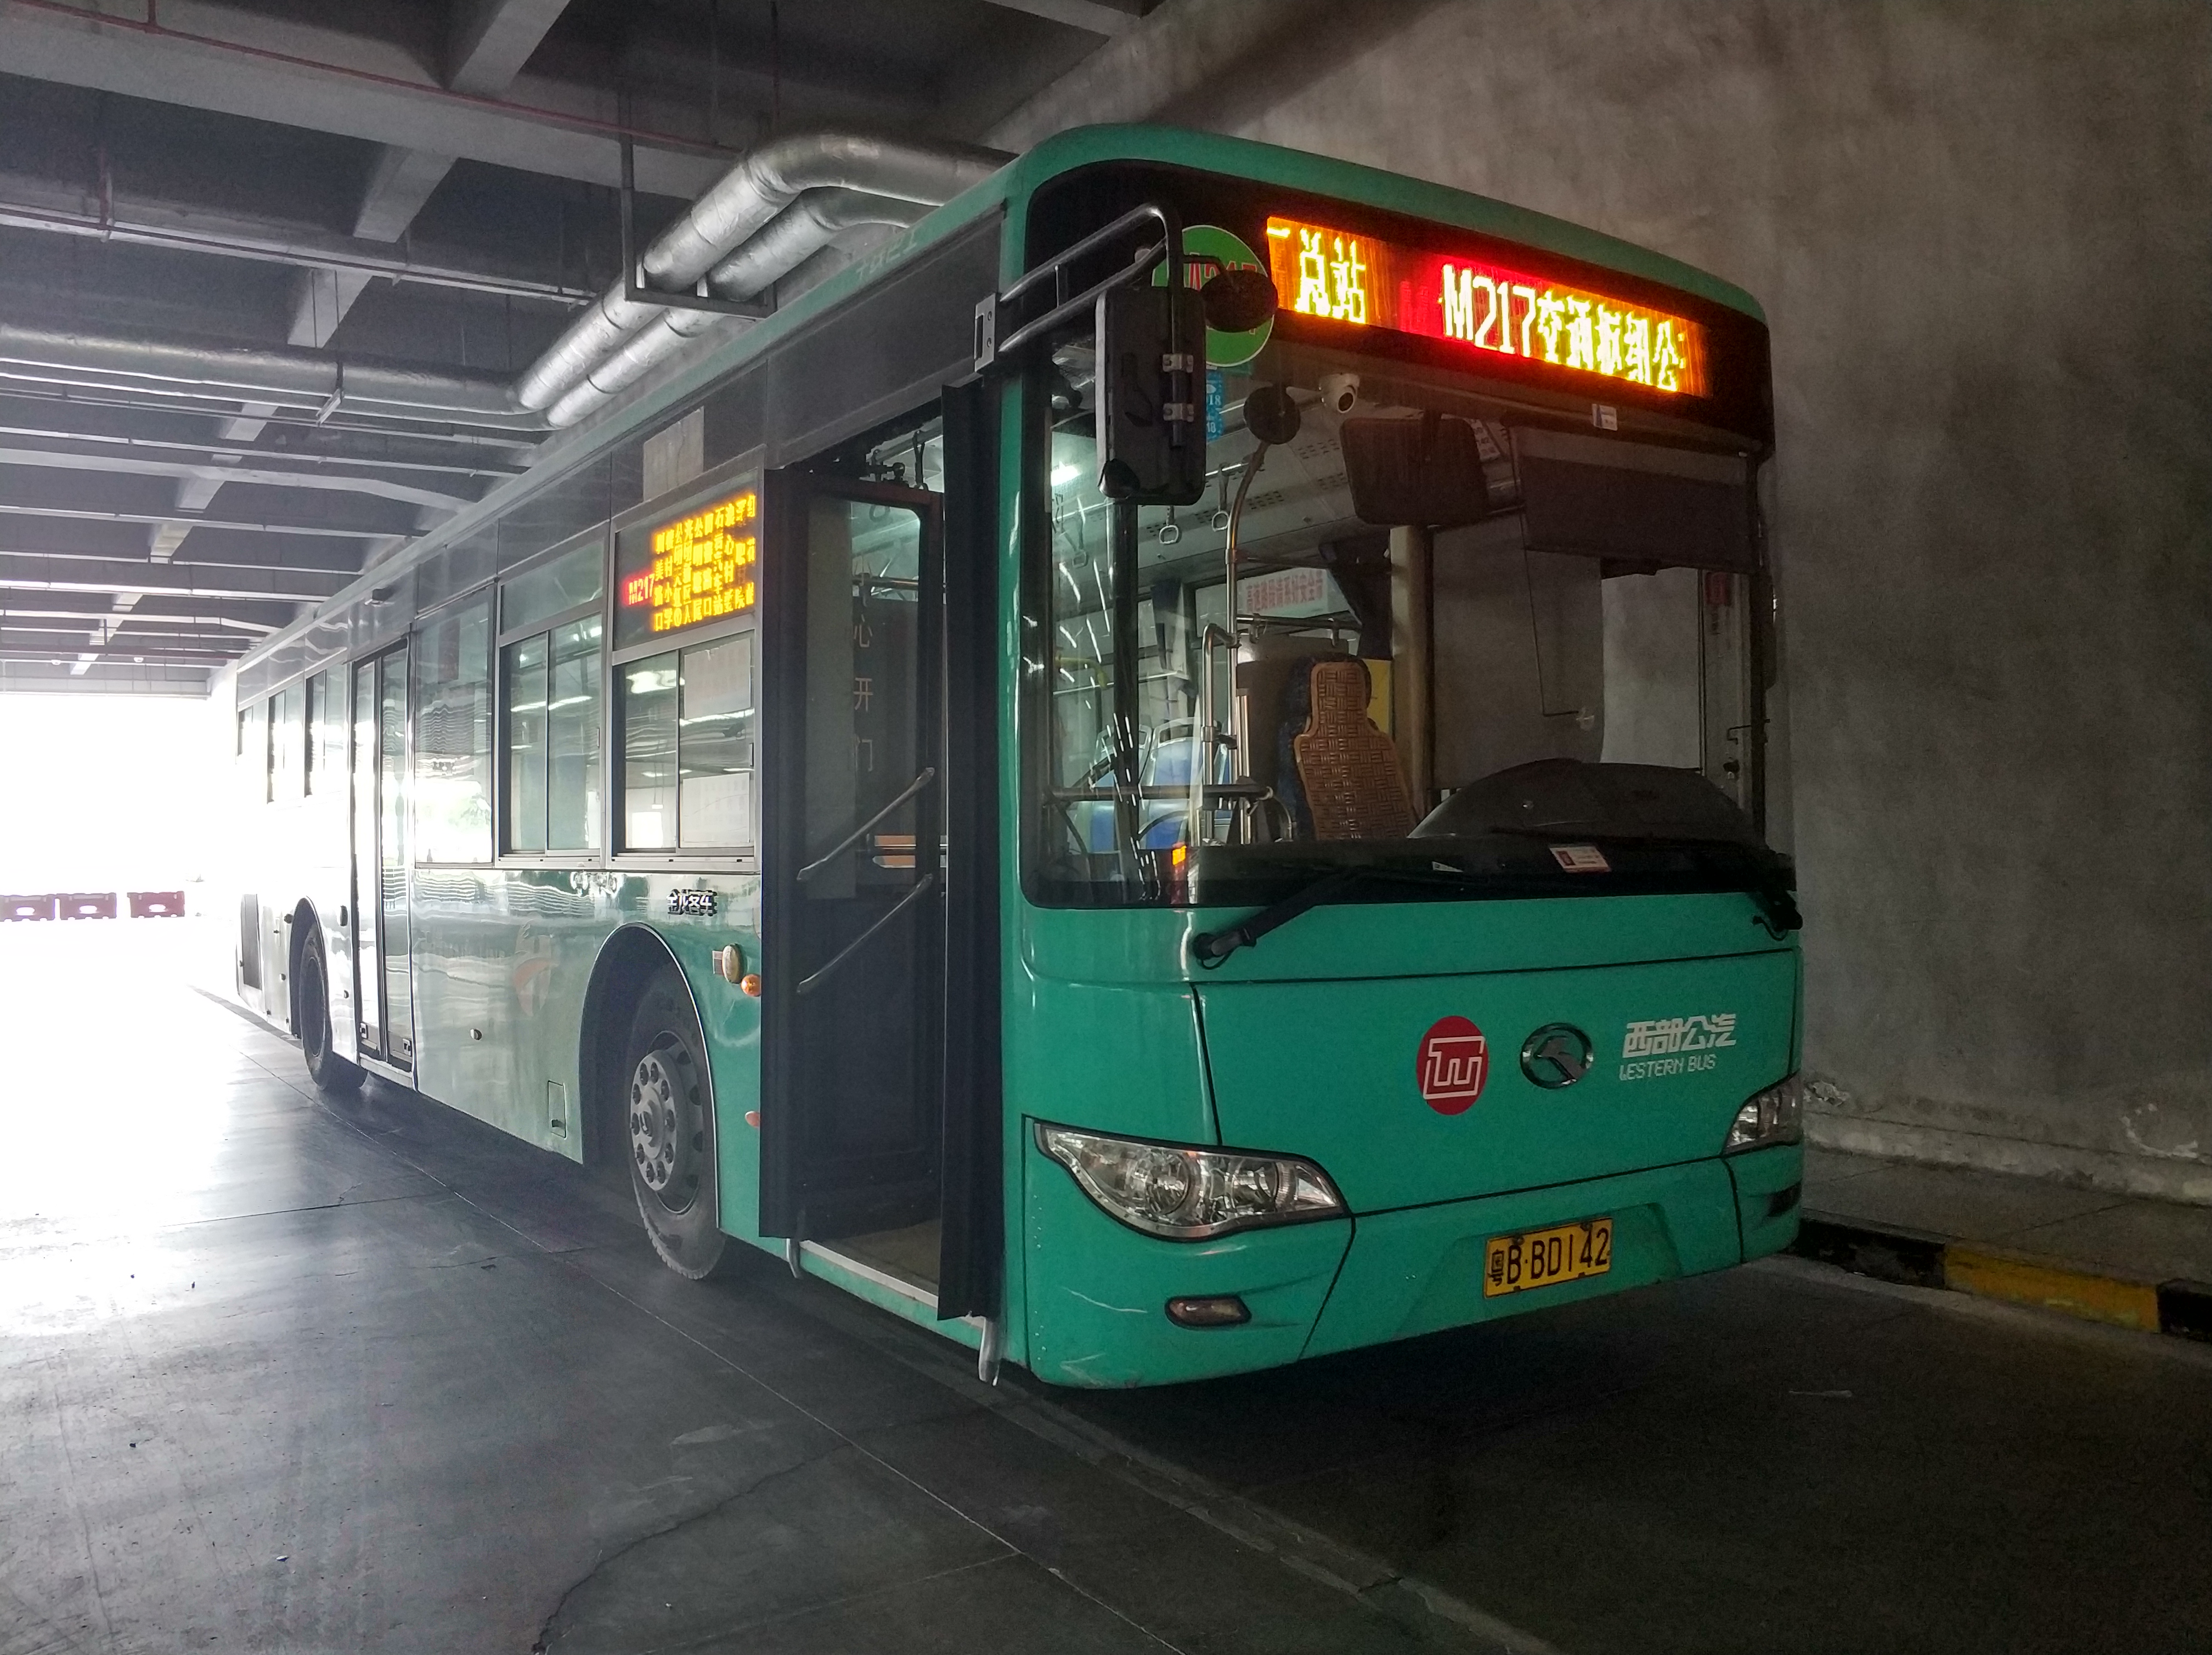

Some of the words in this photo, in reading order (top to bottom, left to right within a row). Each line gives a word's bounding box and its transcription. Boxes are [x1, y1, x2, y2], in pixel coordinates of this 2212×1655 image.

[1267, 227, 1366, 324] 总站
[629, 573, 655, 605] M217
[1622, 1014, 1736, 1058] 西部公汽
[1688, 1054, 1717, 1072] BUS
